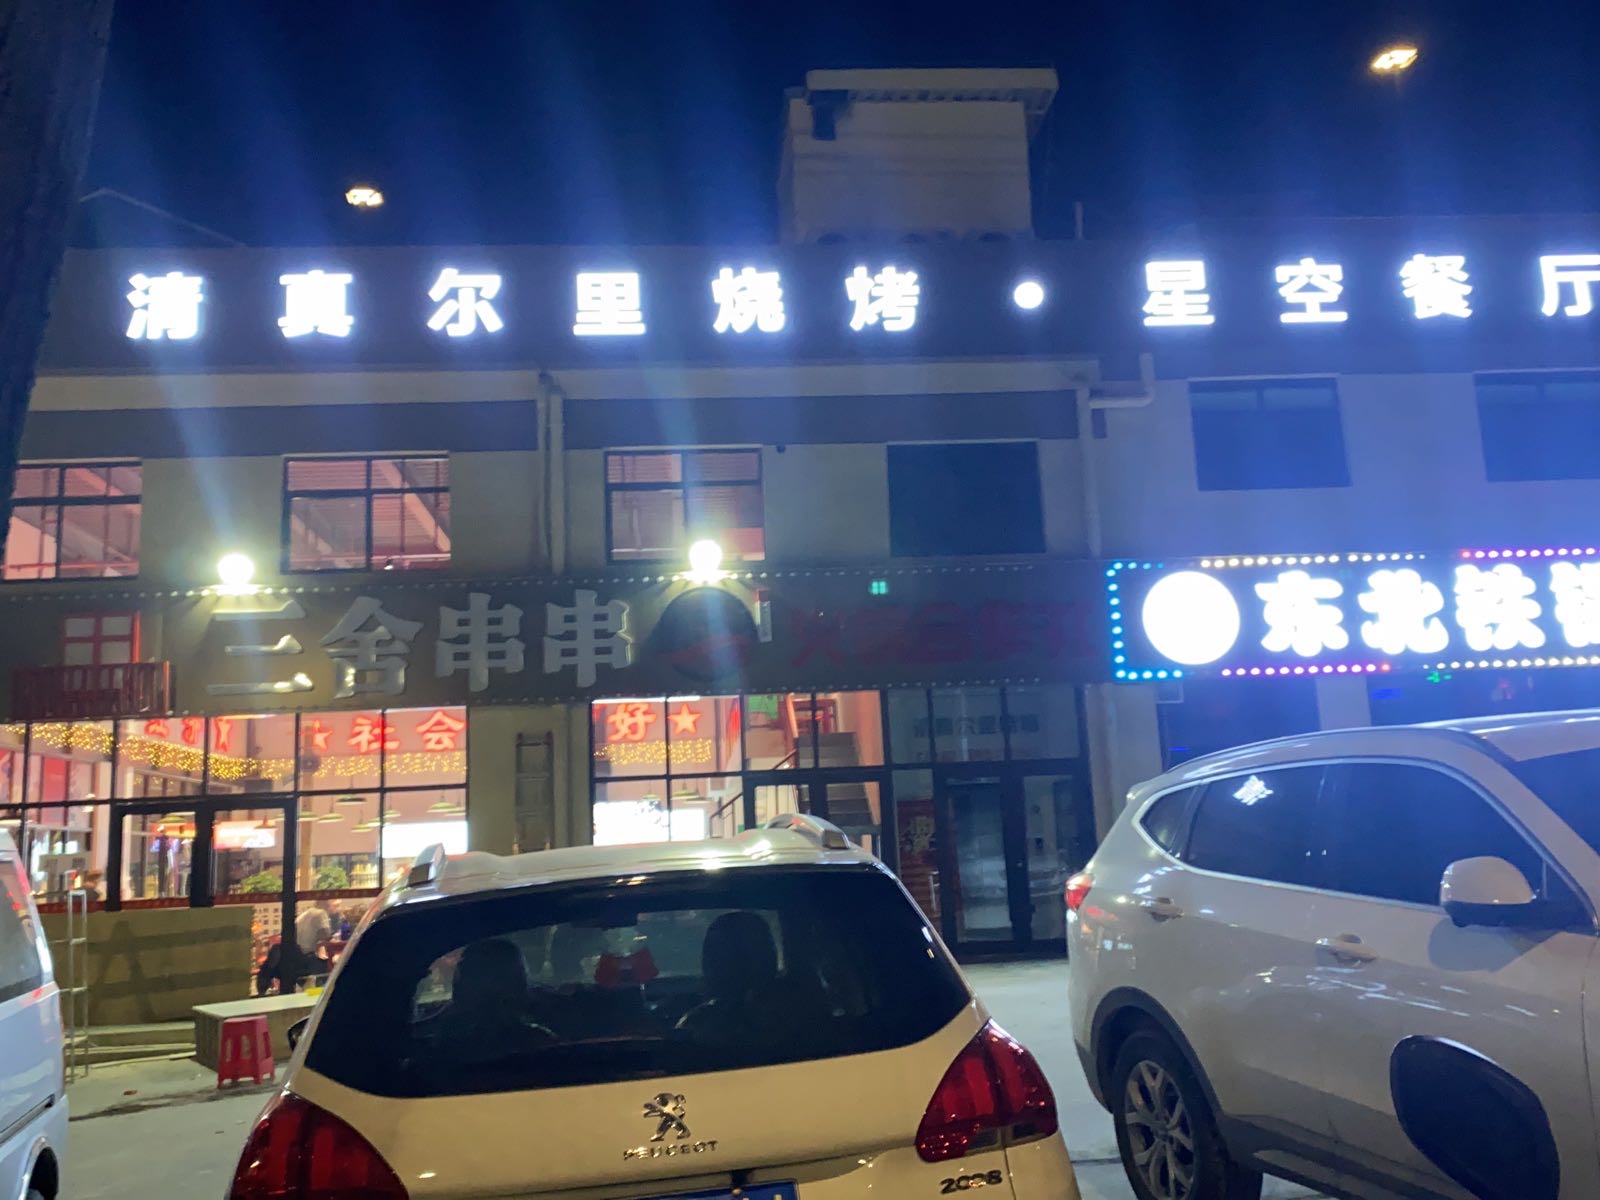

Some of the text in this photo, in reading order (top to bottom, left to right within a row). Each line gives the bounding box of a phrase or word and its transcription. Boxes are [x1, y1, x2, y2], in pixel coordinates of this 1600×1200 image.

[346, 708, 467, 755] 社会
[606, 702, 658, 743] 好
[622, 1140, 719, 1161] PEUGEOT
[939, 1169, 1003, 1195] 2008
